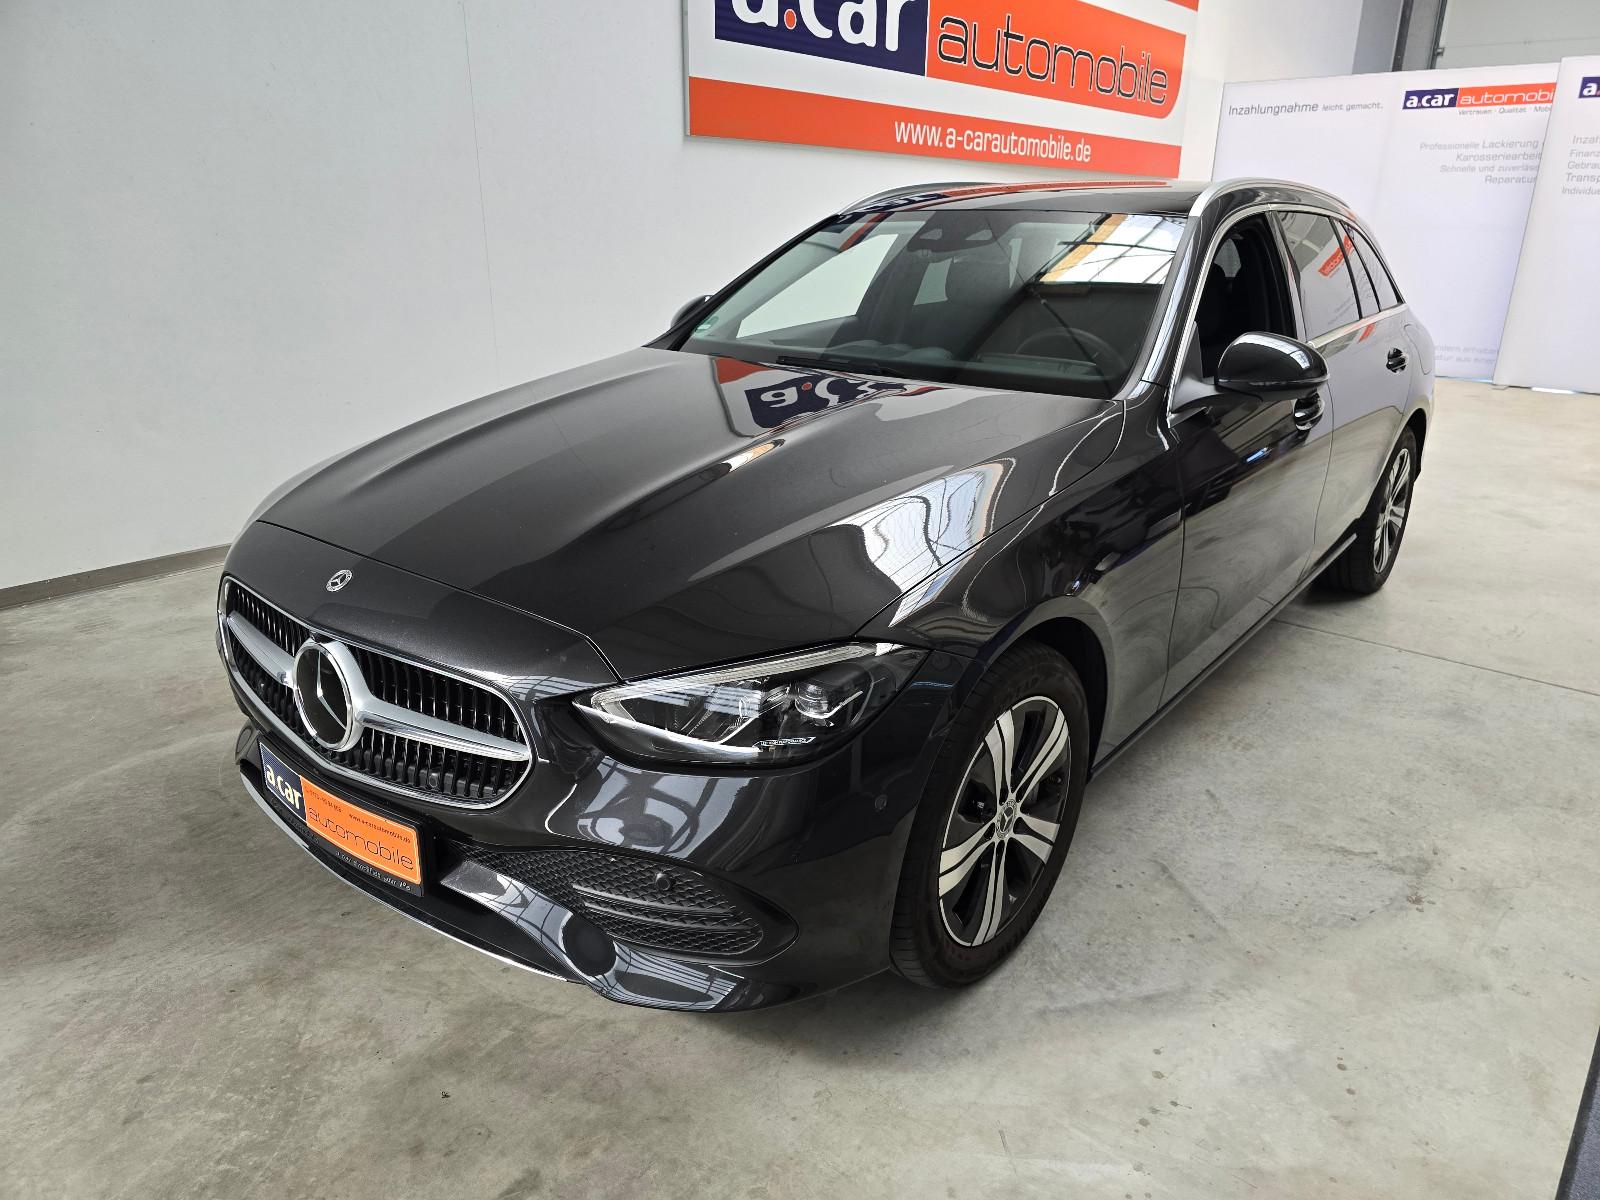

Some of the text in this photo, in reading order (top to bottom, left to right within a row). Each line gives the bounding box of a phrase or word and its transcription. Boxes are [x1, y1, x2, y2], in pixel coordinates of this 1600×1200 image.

[937, 13, 1169, 105] automobile
[1406, 93, 1455, 108] a.car
[1228, 101, 1383, 117] Inzahlungnahme leicht gemacht.
[894, 121, 1091, 162] www.a-carautomobile.de
[1420, 138, 1539, 151] Professionelle Lackierung
[1440, 164, 1476, 173] Schnelle
[1478, 165, 1495, 173] und
[308, 806, 414, 870] automobile
